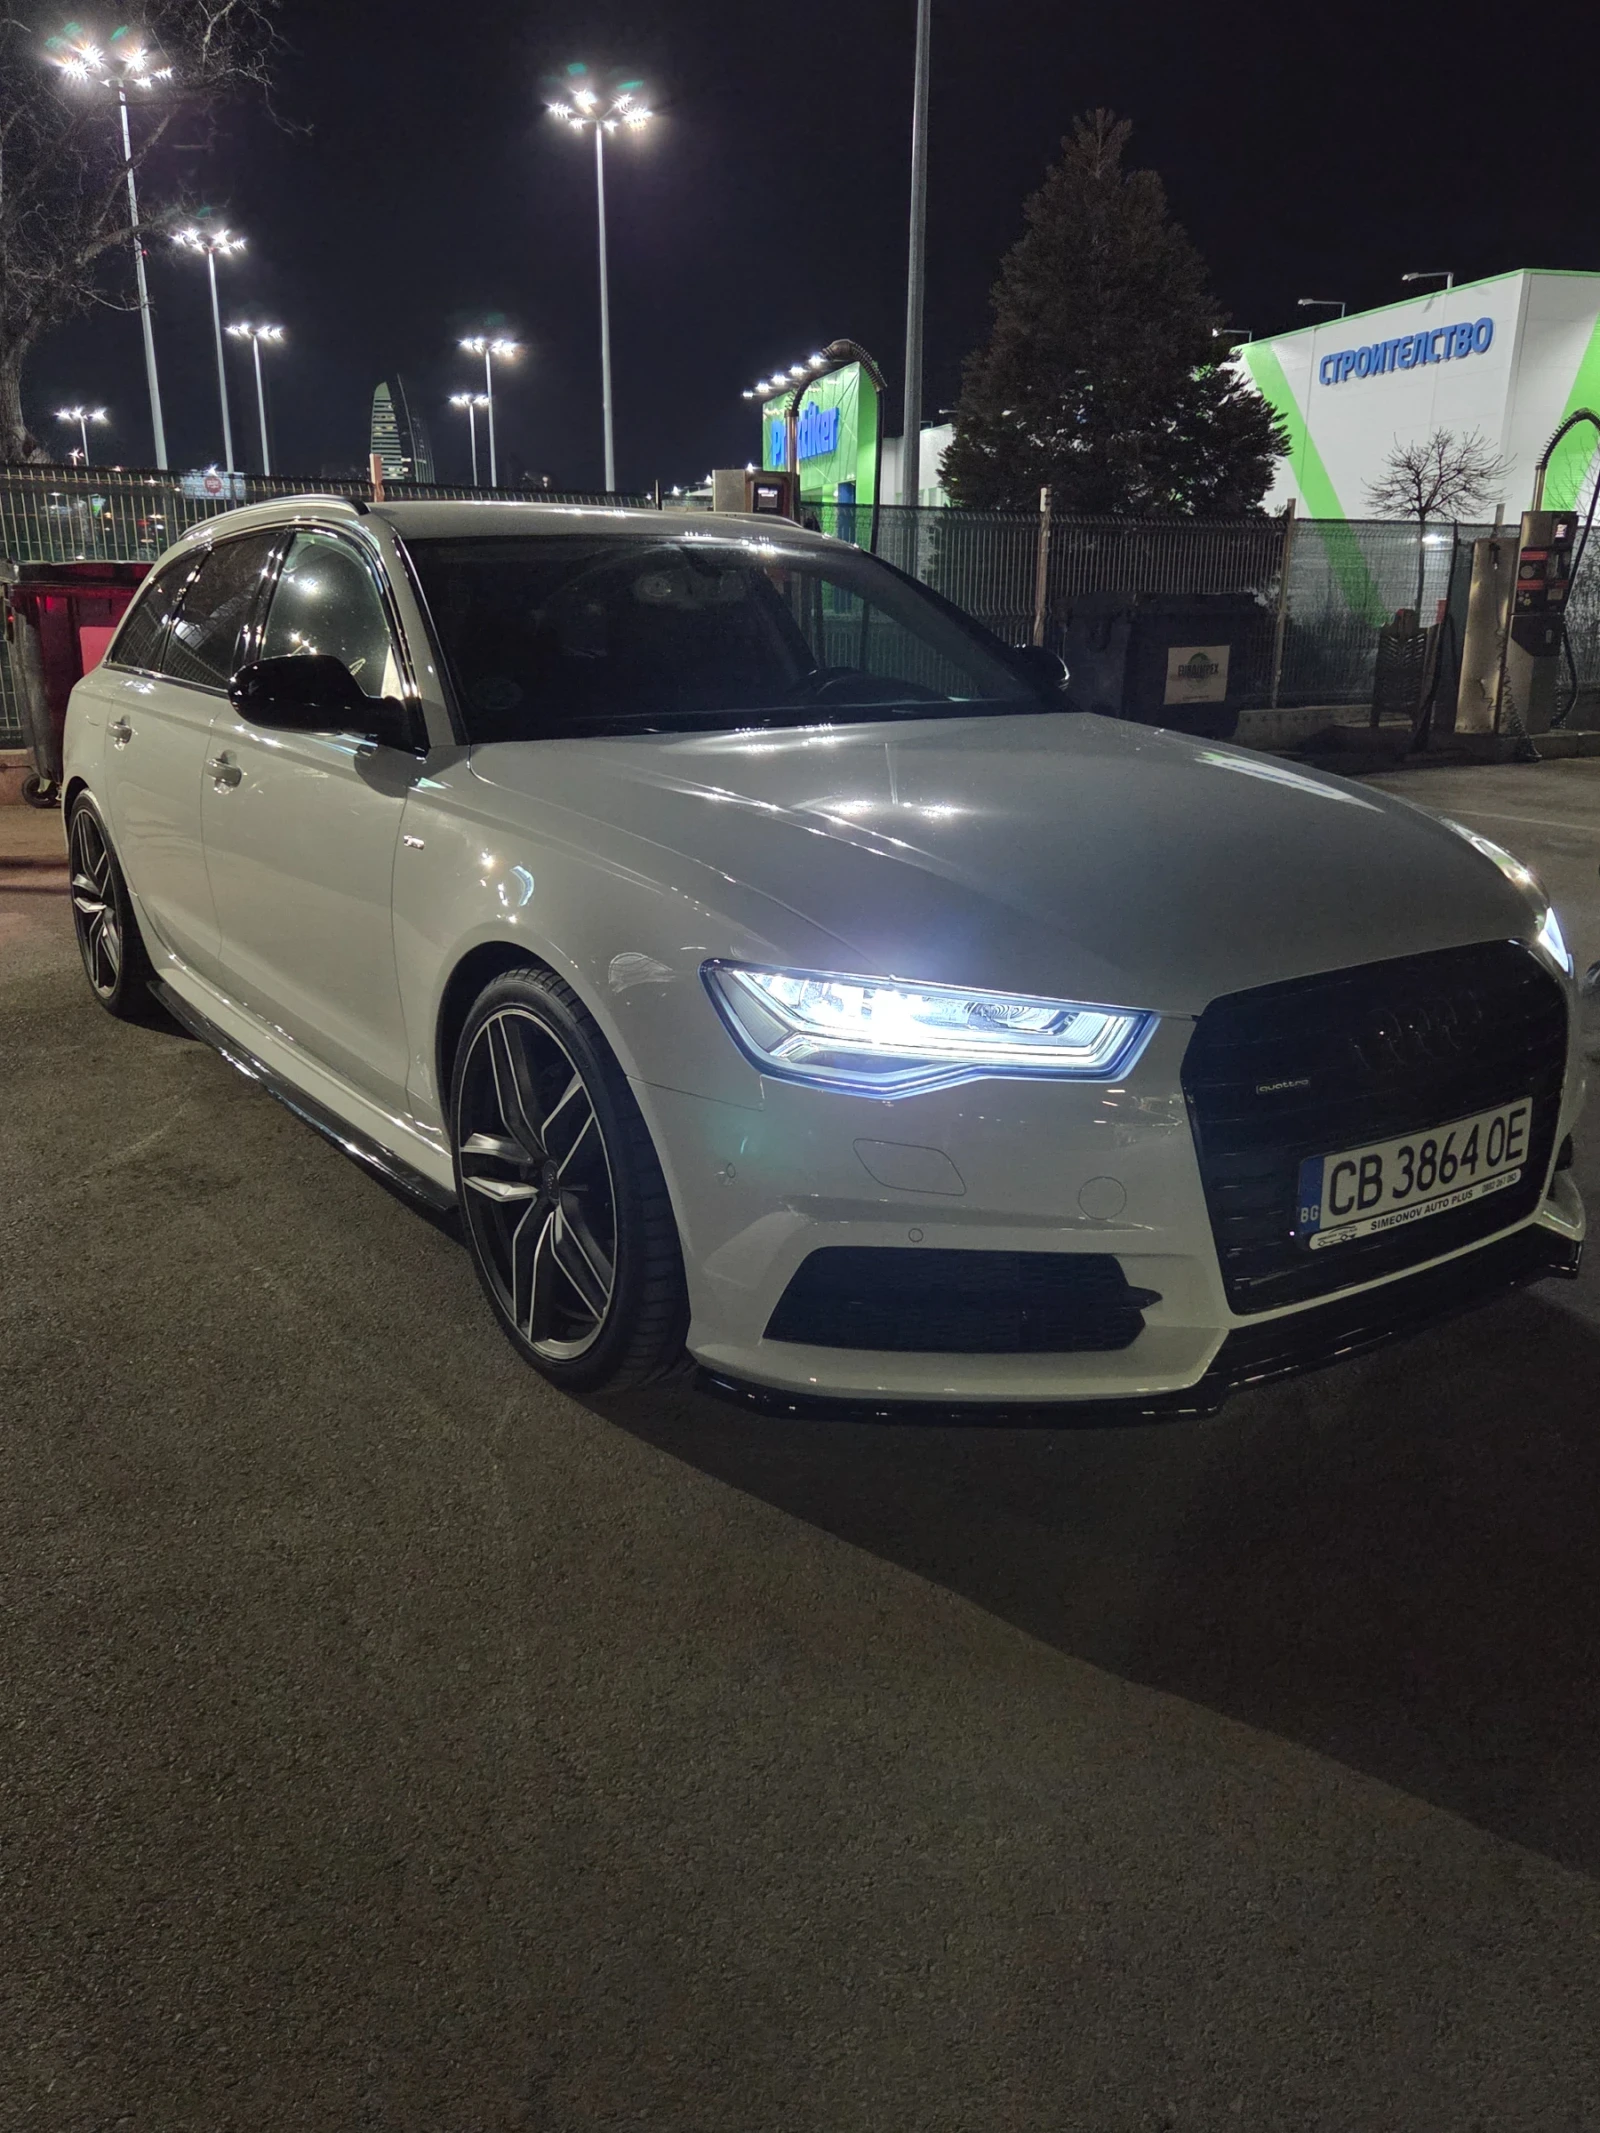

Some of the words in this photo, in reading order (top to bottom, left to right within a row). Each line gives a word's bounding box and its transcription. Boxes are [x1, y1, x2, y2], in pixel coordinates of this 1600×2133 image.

[1319, 317, 1494, 385] СТРОИТЕЛСТВО
[771, 401, 840, 467] Prktiker
[1259, 1079, 1309, 1093] quattro
[1329, 1154, 1383, 1216] CB
[1392, 1123, 1479, 1199] 3864
[1301, 1205, 1319, 1223] BG
[1370, 1207, 1423, 1231] SIMEONOV
[1424, 1198, 1449, 1214] AUTO
[1451, 1190, 1473, 1205] PLUS
